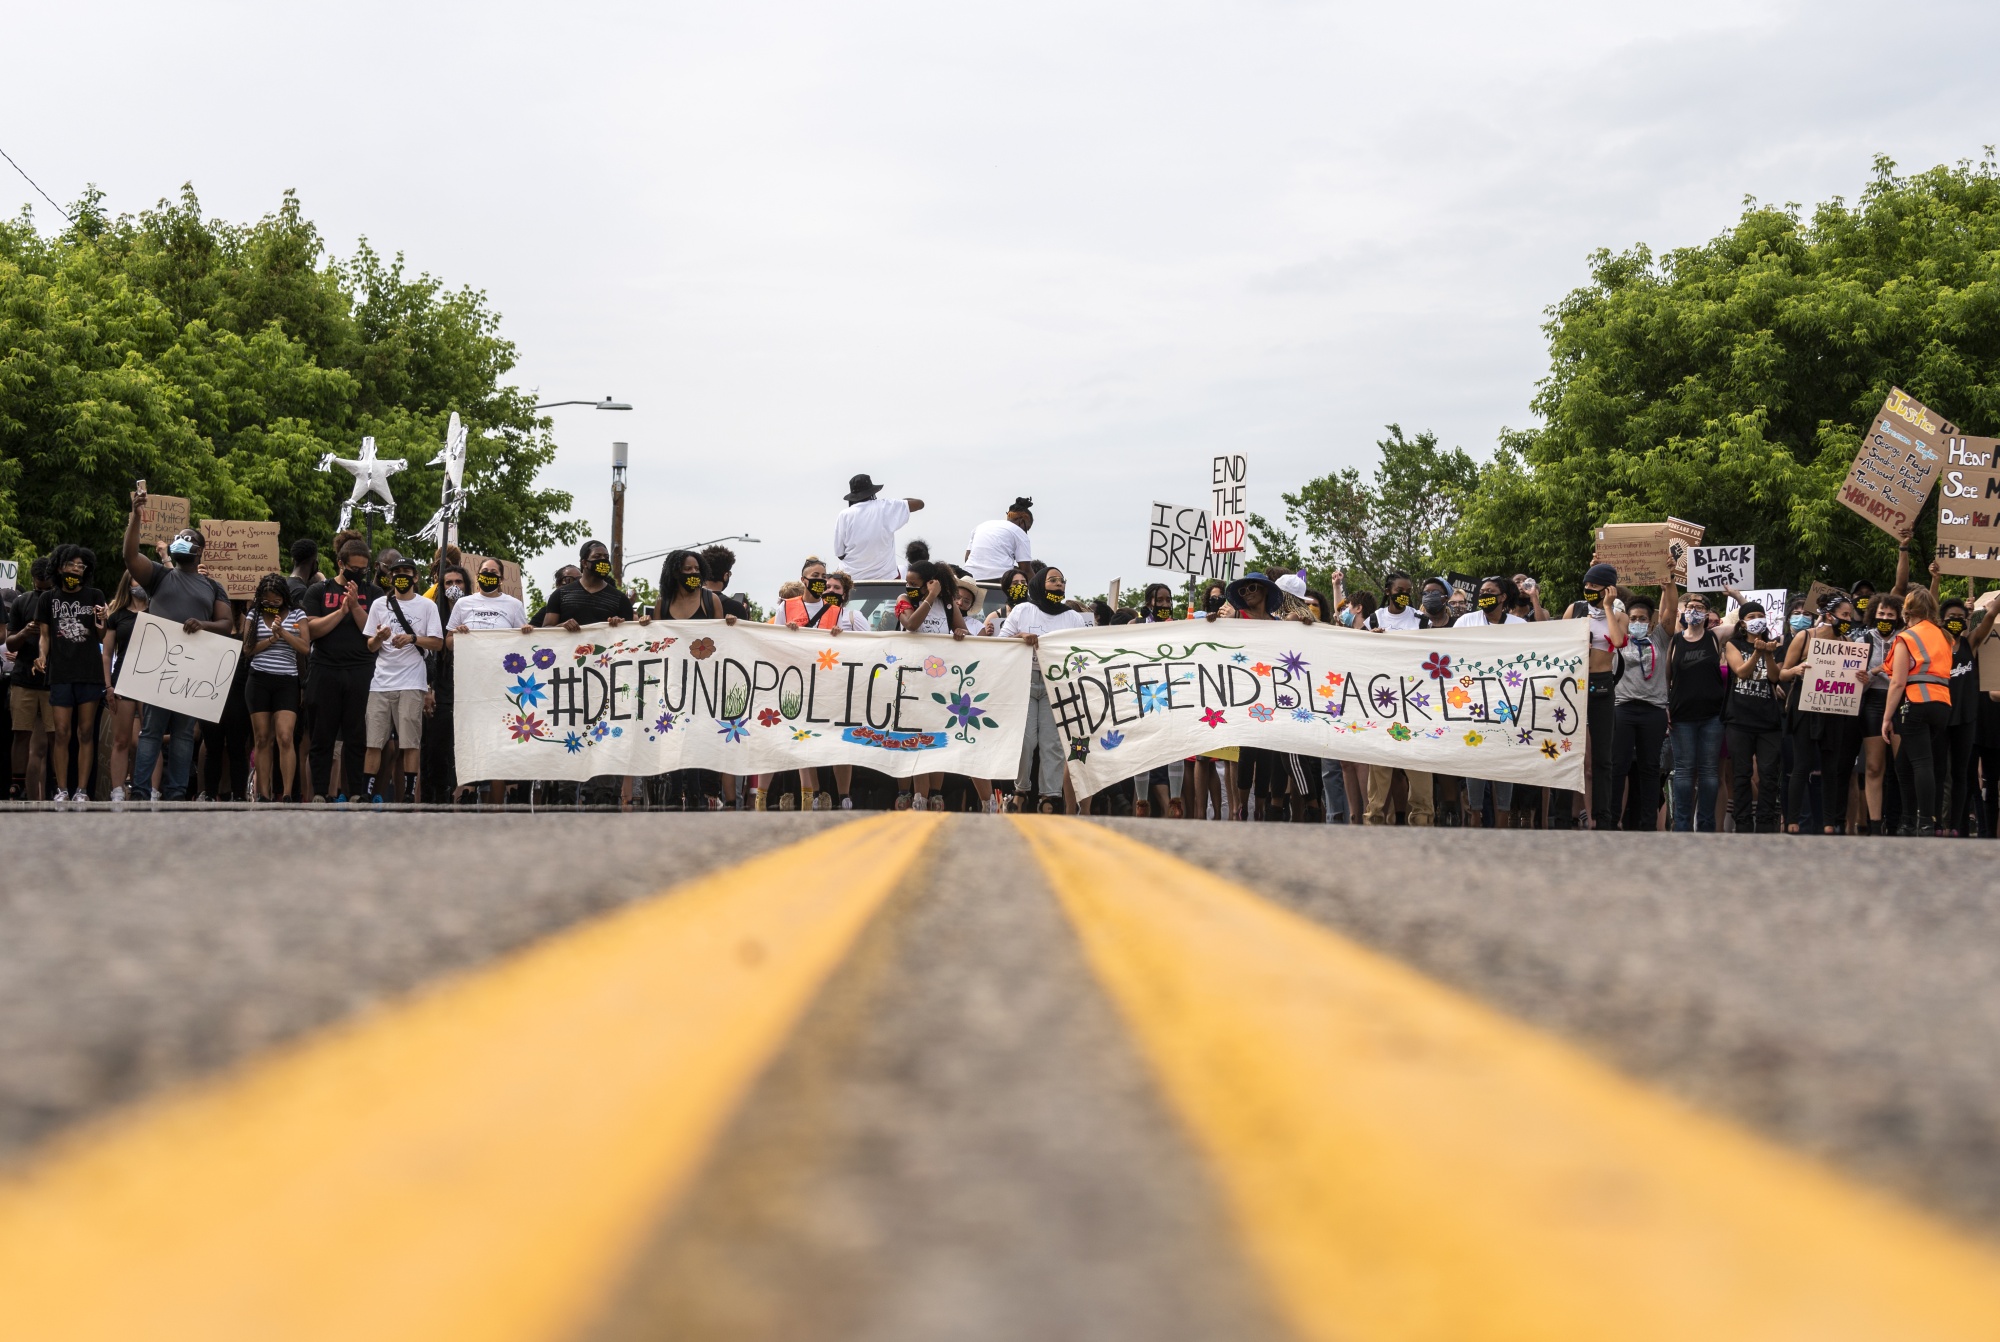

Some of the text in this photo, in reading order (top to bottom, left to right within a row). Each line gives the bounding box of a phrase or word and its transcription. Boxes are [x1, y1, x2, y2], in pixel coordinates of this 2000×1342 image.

[1886, 388, 1937, 436] Justice
[1948, 437, 1991, 466] Hear
[1213, 455, 1246, 484] END
[1898, 465, 1923, 484] Bland
[1905, 453, 1932, 477] Floyd
[1896, 478, 1926, 503] Arbery
[1942, 471, 1979, 498] See
[1212, 485, 1246, 517] THE
[1880, 485, 1900, 506] Rice
[155, 523, 180, 532] Black
[1151, 503, 1212, 539] I CA
[1972, 511, 1990, 527] Kill
[204, 524, 222, 539] You
[1212, 519, 1245, 552] MPD
[203, 540, 237, 551] FREEDOM
[203, 551, 231, 561] PEACE
[1693, 546, 1752, 568] BLACK
[255, 565, 265, 573] be
[1452, 579, 1477, 592] MELT
[1683, 650, 1707, 661] NIKE
[1813, 640, 1869, 659] BLACKNESS
[1842, 659, 1862, 669] NOT
[157, 649, 237, 701] FUND!
[1825, 669, 1846, 679] BE A
[1815, 678, 1856, 695] DEATH
[1804, 692, 1857, 709] SENTENCE
